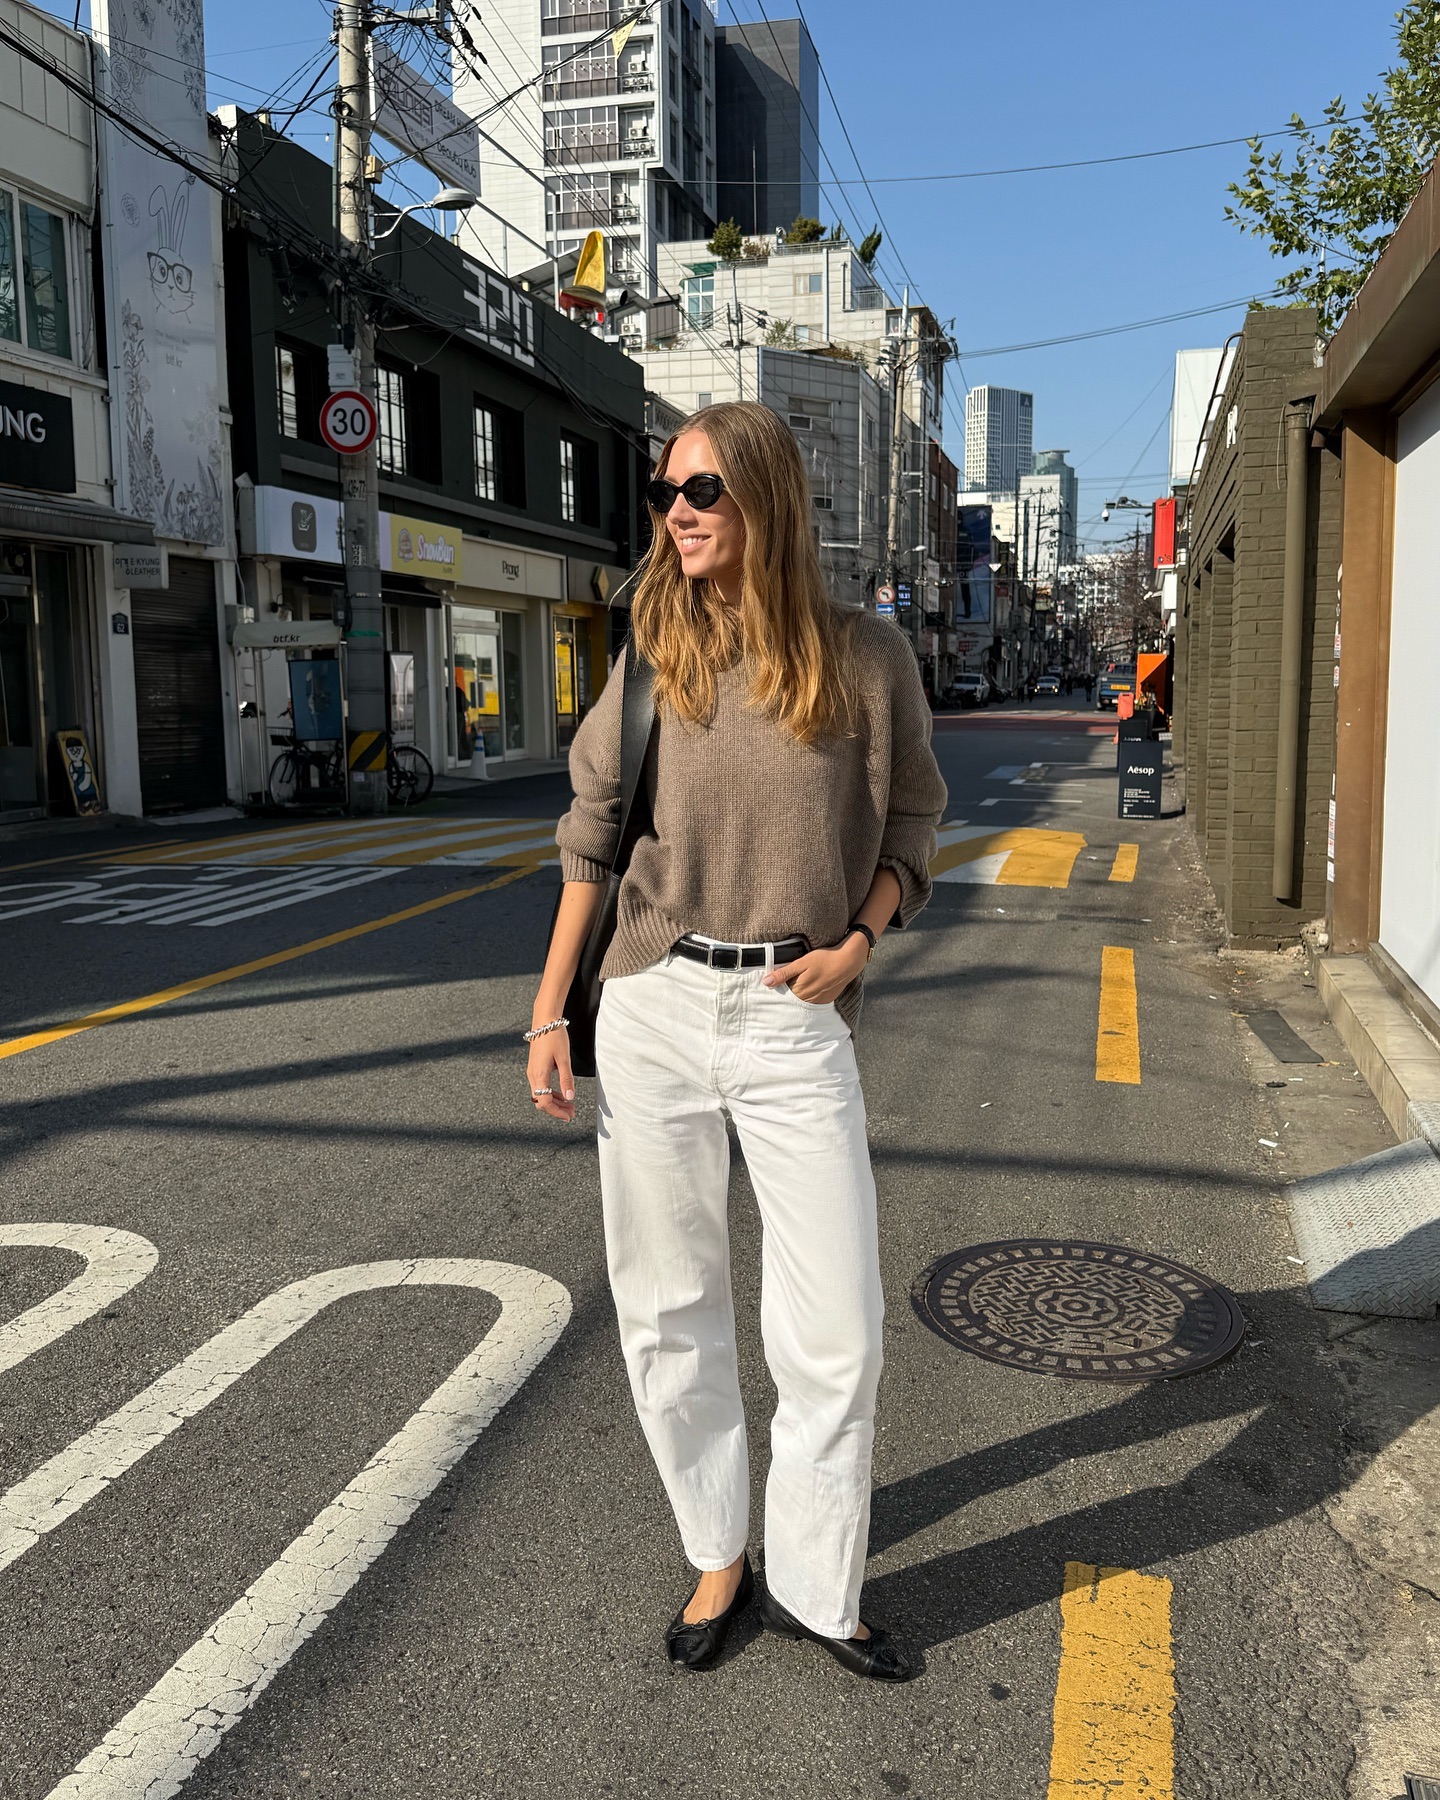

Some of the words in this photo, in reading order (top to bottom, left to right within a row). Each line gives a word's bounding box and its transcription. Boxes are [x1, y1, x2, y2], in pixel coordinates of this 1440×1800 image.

[332, 408, 366, 436] 30
[136, 558, 160, 566] KYUNG
[130, 567, 161, 576] LEATHER
[502, 560, 520, 578] Prong
